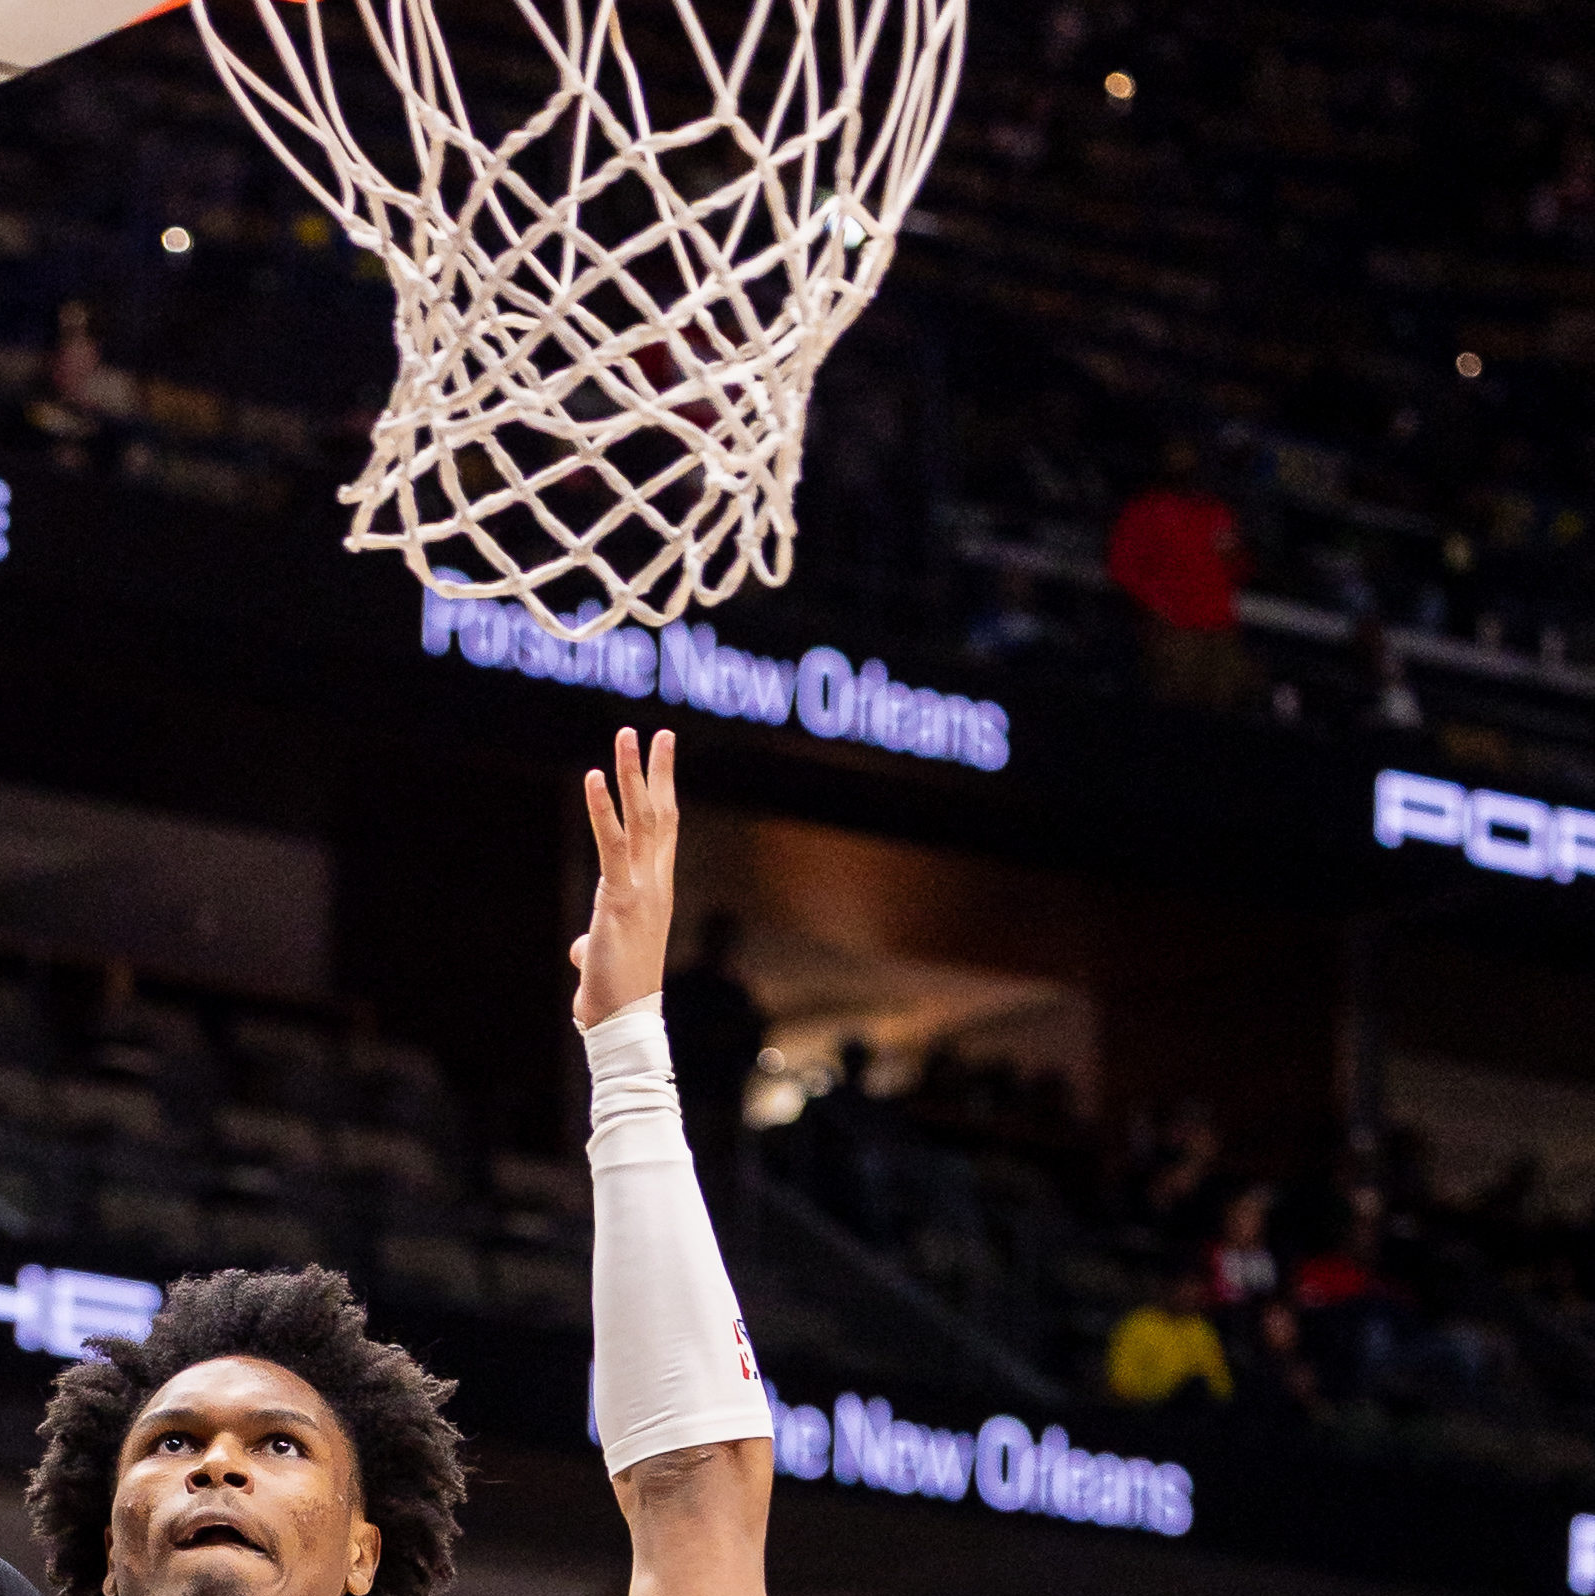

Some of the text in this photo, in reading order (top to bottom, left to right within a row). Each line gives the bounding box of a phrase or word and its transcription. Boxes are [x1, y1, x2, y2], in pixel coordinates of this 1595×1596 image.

[658, 618, 797, 726] New
[797, 646, 1010, 772] Orleans
[833, 1392, 974, 1502] New
[975, 1413, 1193, 1536] Orleans
